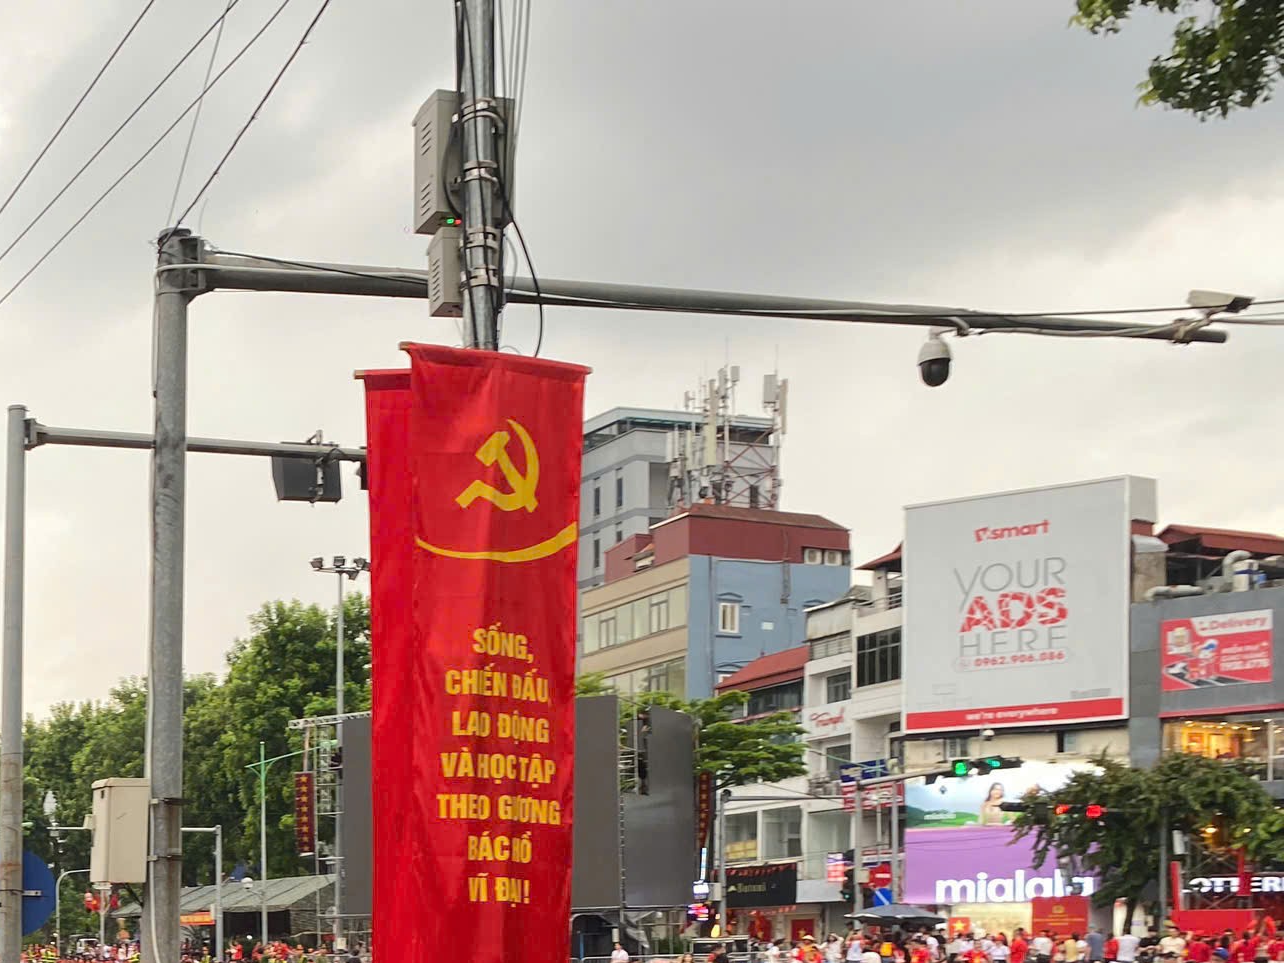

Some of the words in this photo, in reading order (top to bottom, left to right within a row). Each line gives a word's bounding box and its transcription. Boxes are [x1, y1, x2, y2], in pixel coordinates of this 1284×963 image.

[953, 556, 1067, 613] YOUR
[959, 587, 1068, 632] ADS
[471, 622, 534, 664] SỐNG,
[959, 625, 1067, 656] HERE
[445, 662, 507, 697] CHIẾN
[451, 710, 491, 737] LAO
[497, 710, 550, 744] ĐỘNG
[996, 706, 1059, 719] everywhere
[440, 746, 475, 778] VÀ
[477, 753, 516, 784] HỌC
[519, 753, 556, 788] TẬP
[436, 793, 491, 820] THEO
[497, 794, 561, 825] GƯƠNG
[467, 831, 510, 861] BÁC
[511, 831, 532, 863] HỒ
[467, 872, 488, 902] VĨ
[494, 876, 530, 907] ĐẠI!
